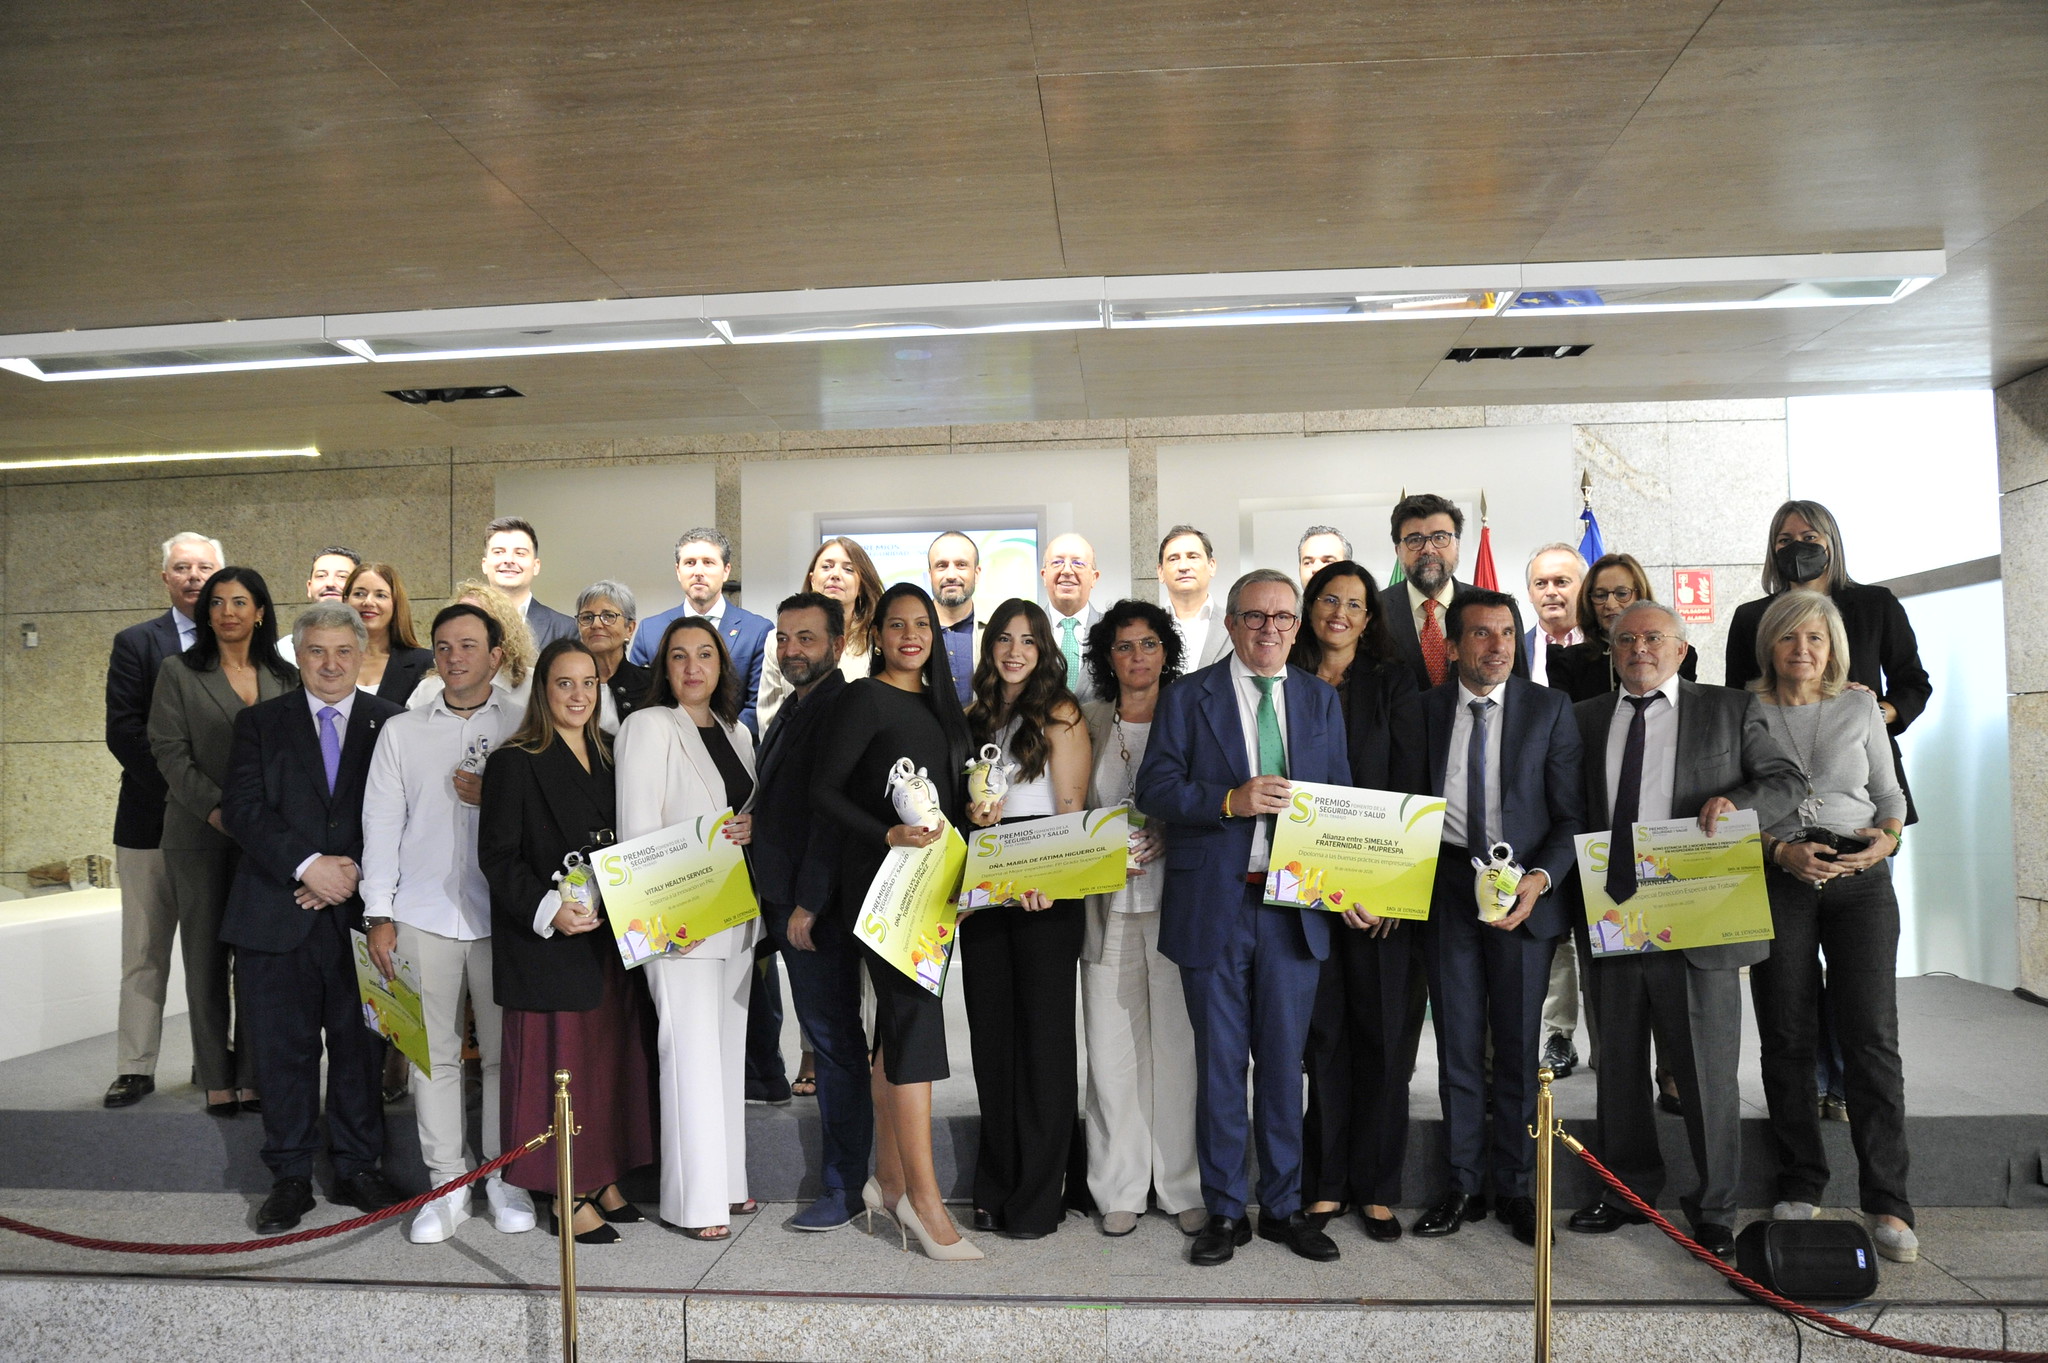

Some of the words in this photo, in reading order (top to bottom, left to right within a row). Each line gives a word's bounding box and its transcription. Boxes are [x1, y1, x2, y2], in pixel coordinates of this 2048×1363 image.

[1314, 796, 1351, 809] PREMIOS
[1319, 805, 1358, 816] SEGURIDAD
[1363, 810, 1386, 819] SALUD
[999, 828, 1034, 841] PREMIOS
[1004, 833, 1041, 845] SEGURIDAD
[1047, 829, 1070, 838] SALUD
[1321, 833, 1346, 842] Alianza
[1346, 836, 1364, 844] entre
[1364, 837, 1393, 846] SIMELSA
[622, 845, 656, 863] PREMIOS
[630, 850, 665, 868] SEGURIDAD
[669, 842, 688, 854] SALUD
[1315, 839, 1362, 850] FRATERNIDAD
[1367, 845, 1404, 855] MUPRESPA
[914, 848, 934, 878] OSCARINA
[989, 862, 1005, 870] DÑA.
[1006, 858, 1028, 868] MARÍA
[1039, 853, 1064, 862] FÁTIMA
[1064, 848, 1095, 858] HIGUERO
[1298, 849, 1324, 858] Dipoloma
[1337, 853, 1357, 862] buenas
[1357, 855, 1380, 865] prácticas
[1380, 859, 1417, 868] empresariales
[644, 884, 664, 896] VITALY
[664, 876, 687, 889] HEALTH
[686, 865, 714, 881] SERVICES
[878, 877, 897, 914] SEGURIDAD
[896, 853, 910, 876] SALUD
[871, 879, 889, 915] PREMIOS
[902, 893, 914, 919] TORRES
